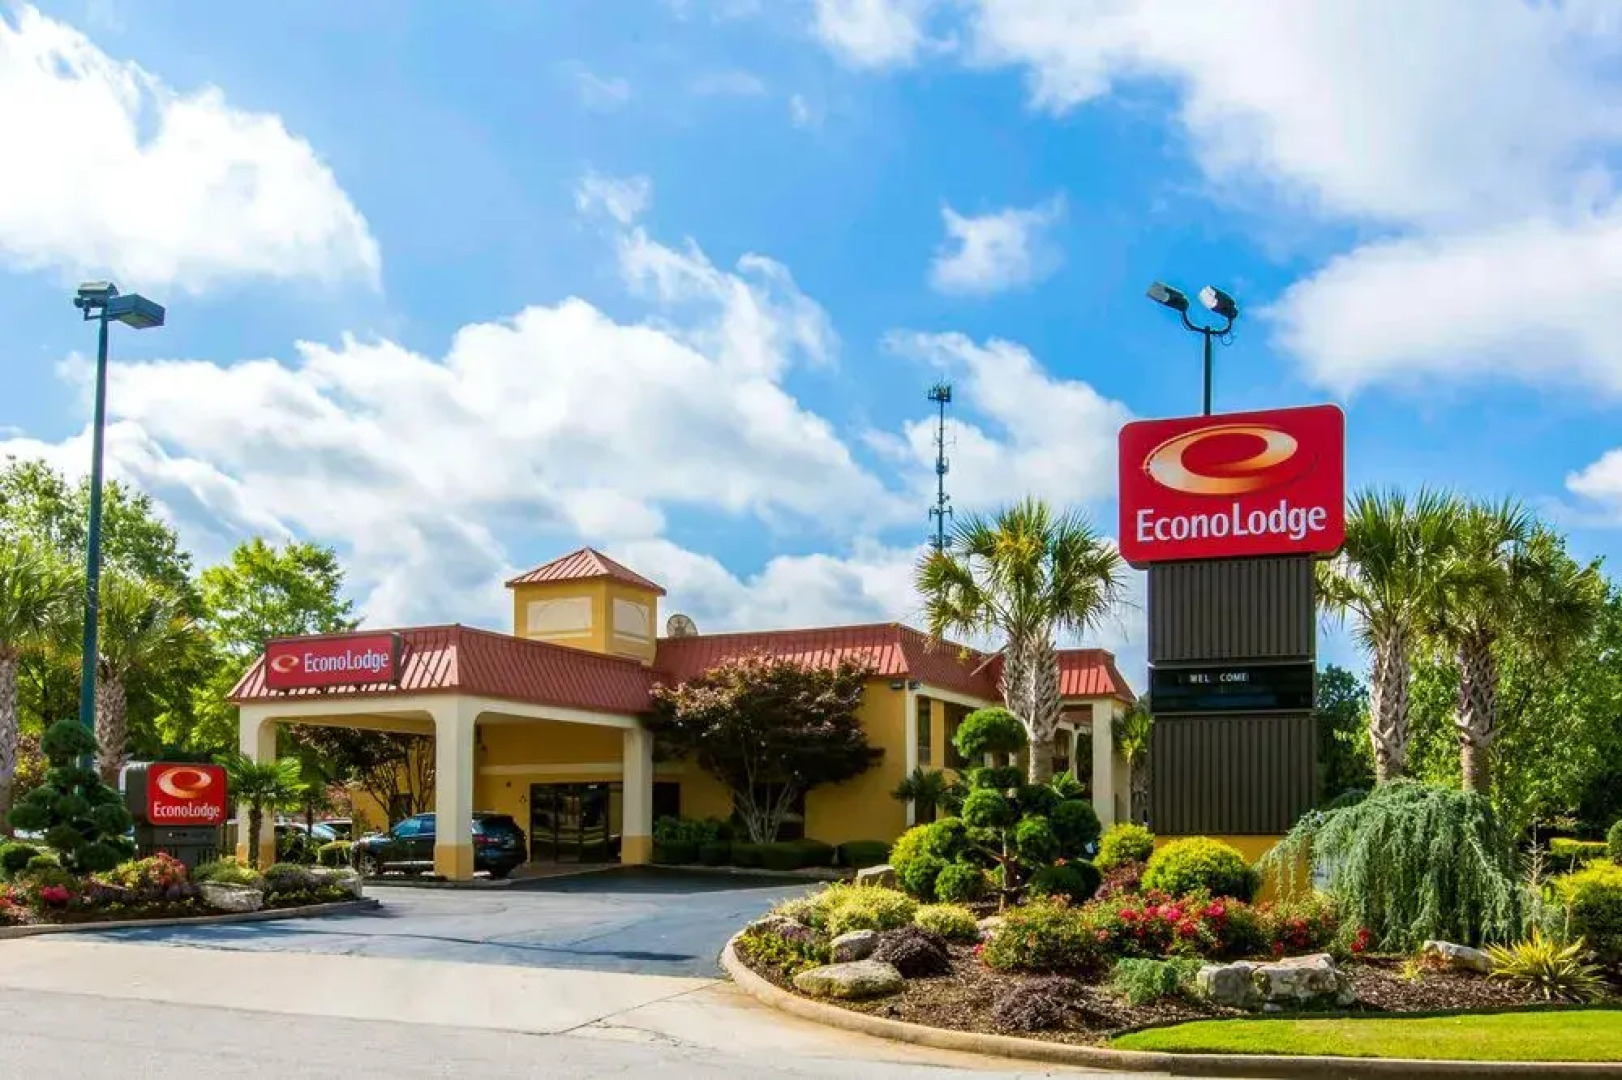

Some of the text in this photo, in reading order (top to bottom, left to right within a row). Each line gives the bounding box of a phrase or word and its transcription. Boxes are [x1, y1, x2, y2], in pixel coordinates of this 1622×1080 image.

[1136, 500, 1327, 542] EconoLodge
[304, 649, 389, 673] EconoLodge
[153, 801, 220, 820] EconoLodge
